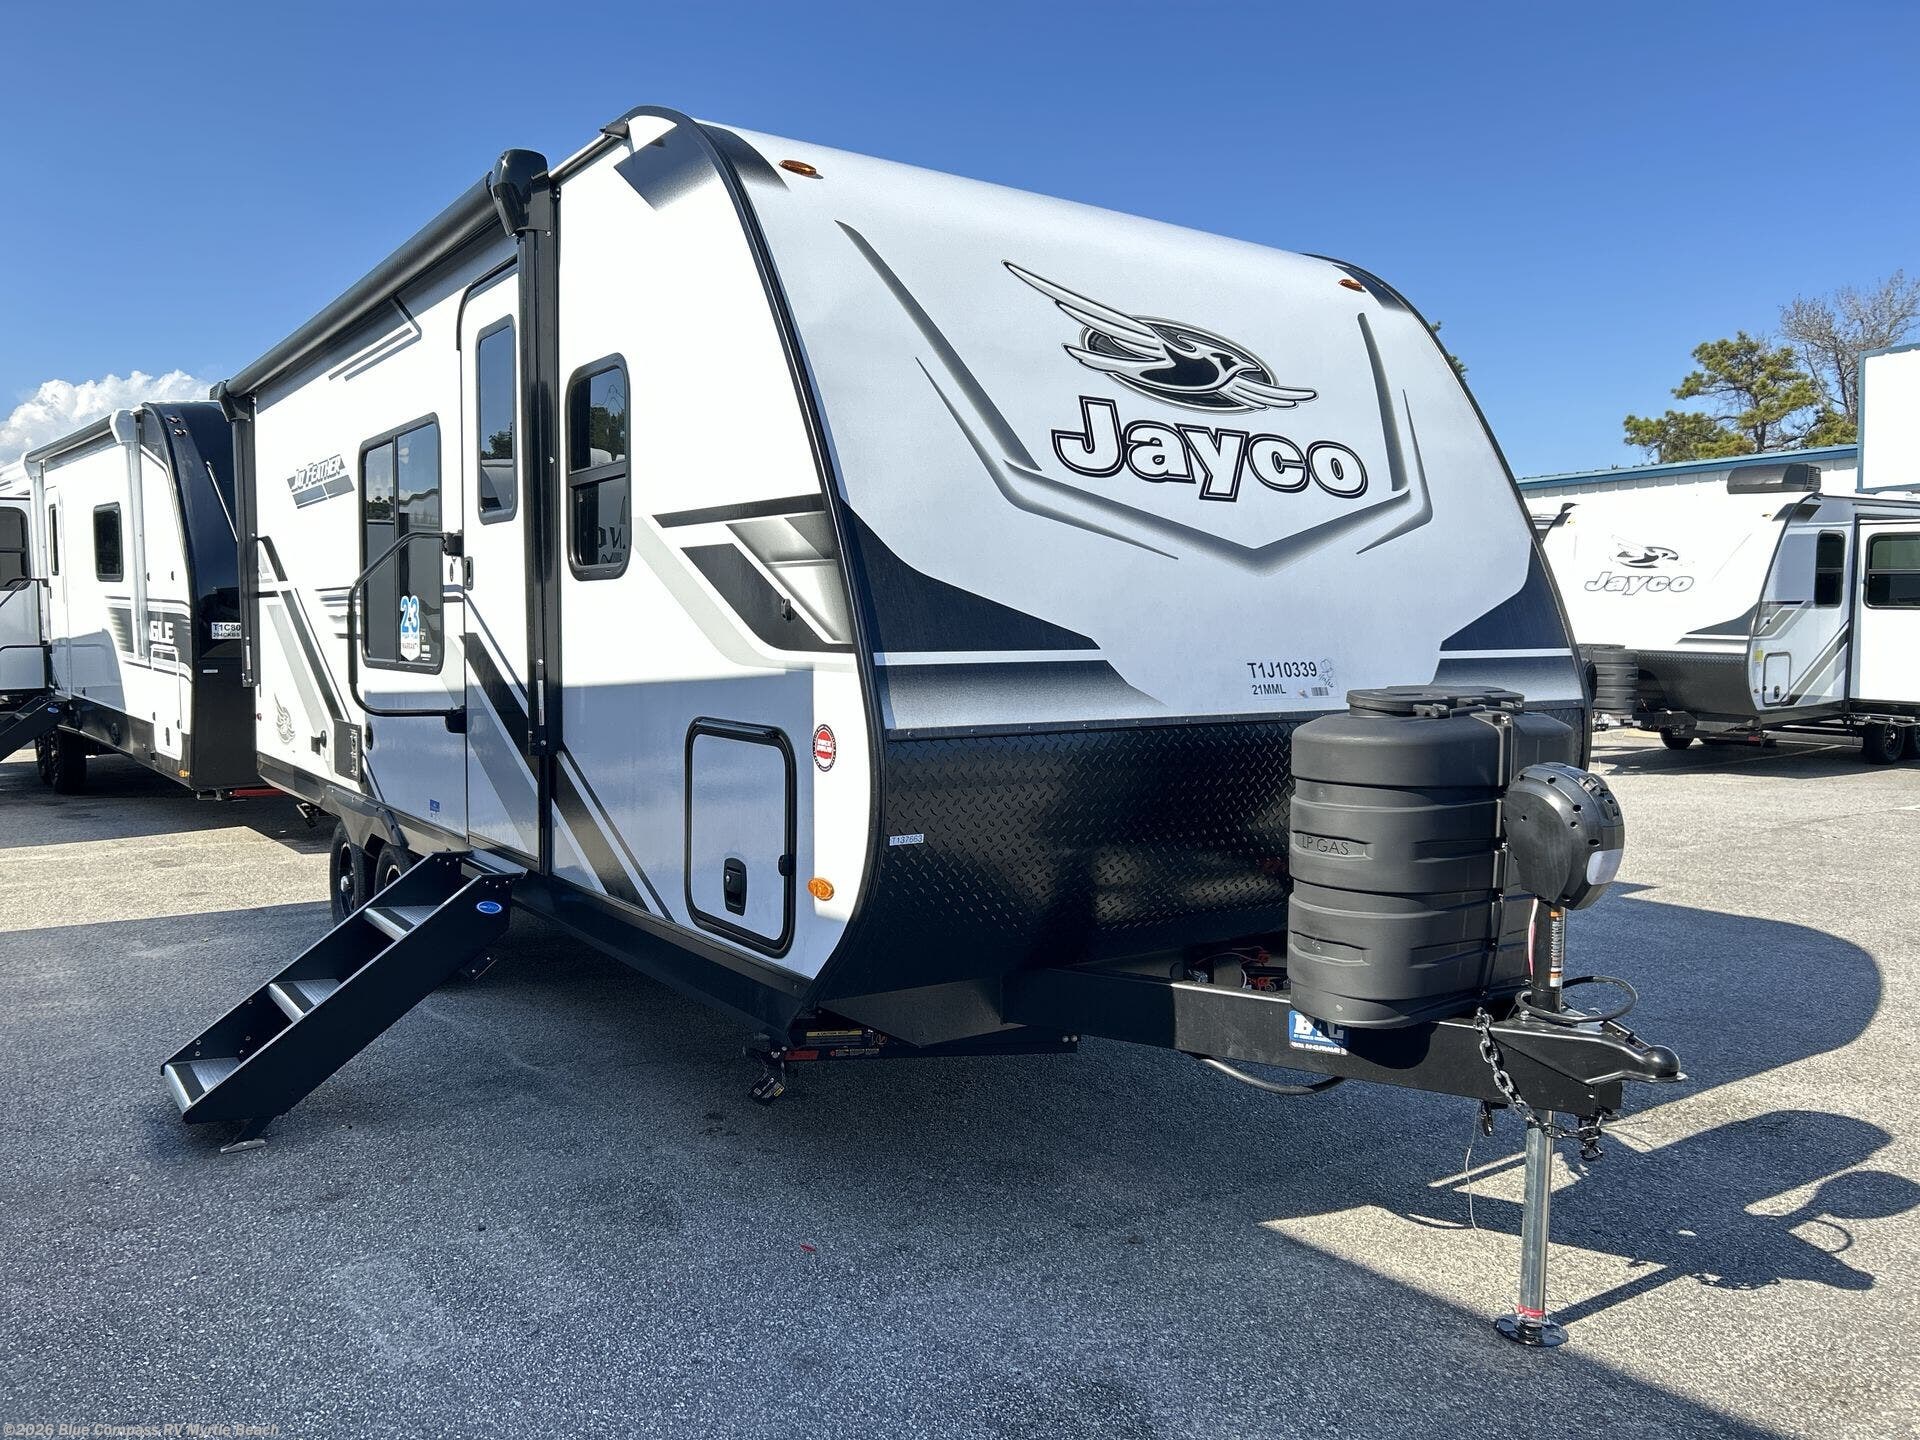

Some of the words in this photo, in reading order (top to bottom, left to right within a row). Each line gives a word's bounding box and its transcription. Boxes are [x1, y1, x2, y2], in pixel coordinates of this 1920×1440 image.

[1051, 395, 1369, 502] Jayco
[1584, 571, 1695, 596] Jayco
[1246, 661, 1318, 679] T1J10339
[1251, 683, 1287, 696] 21MML
[1316, 838, 1350, 856] GAS
